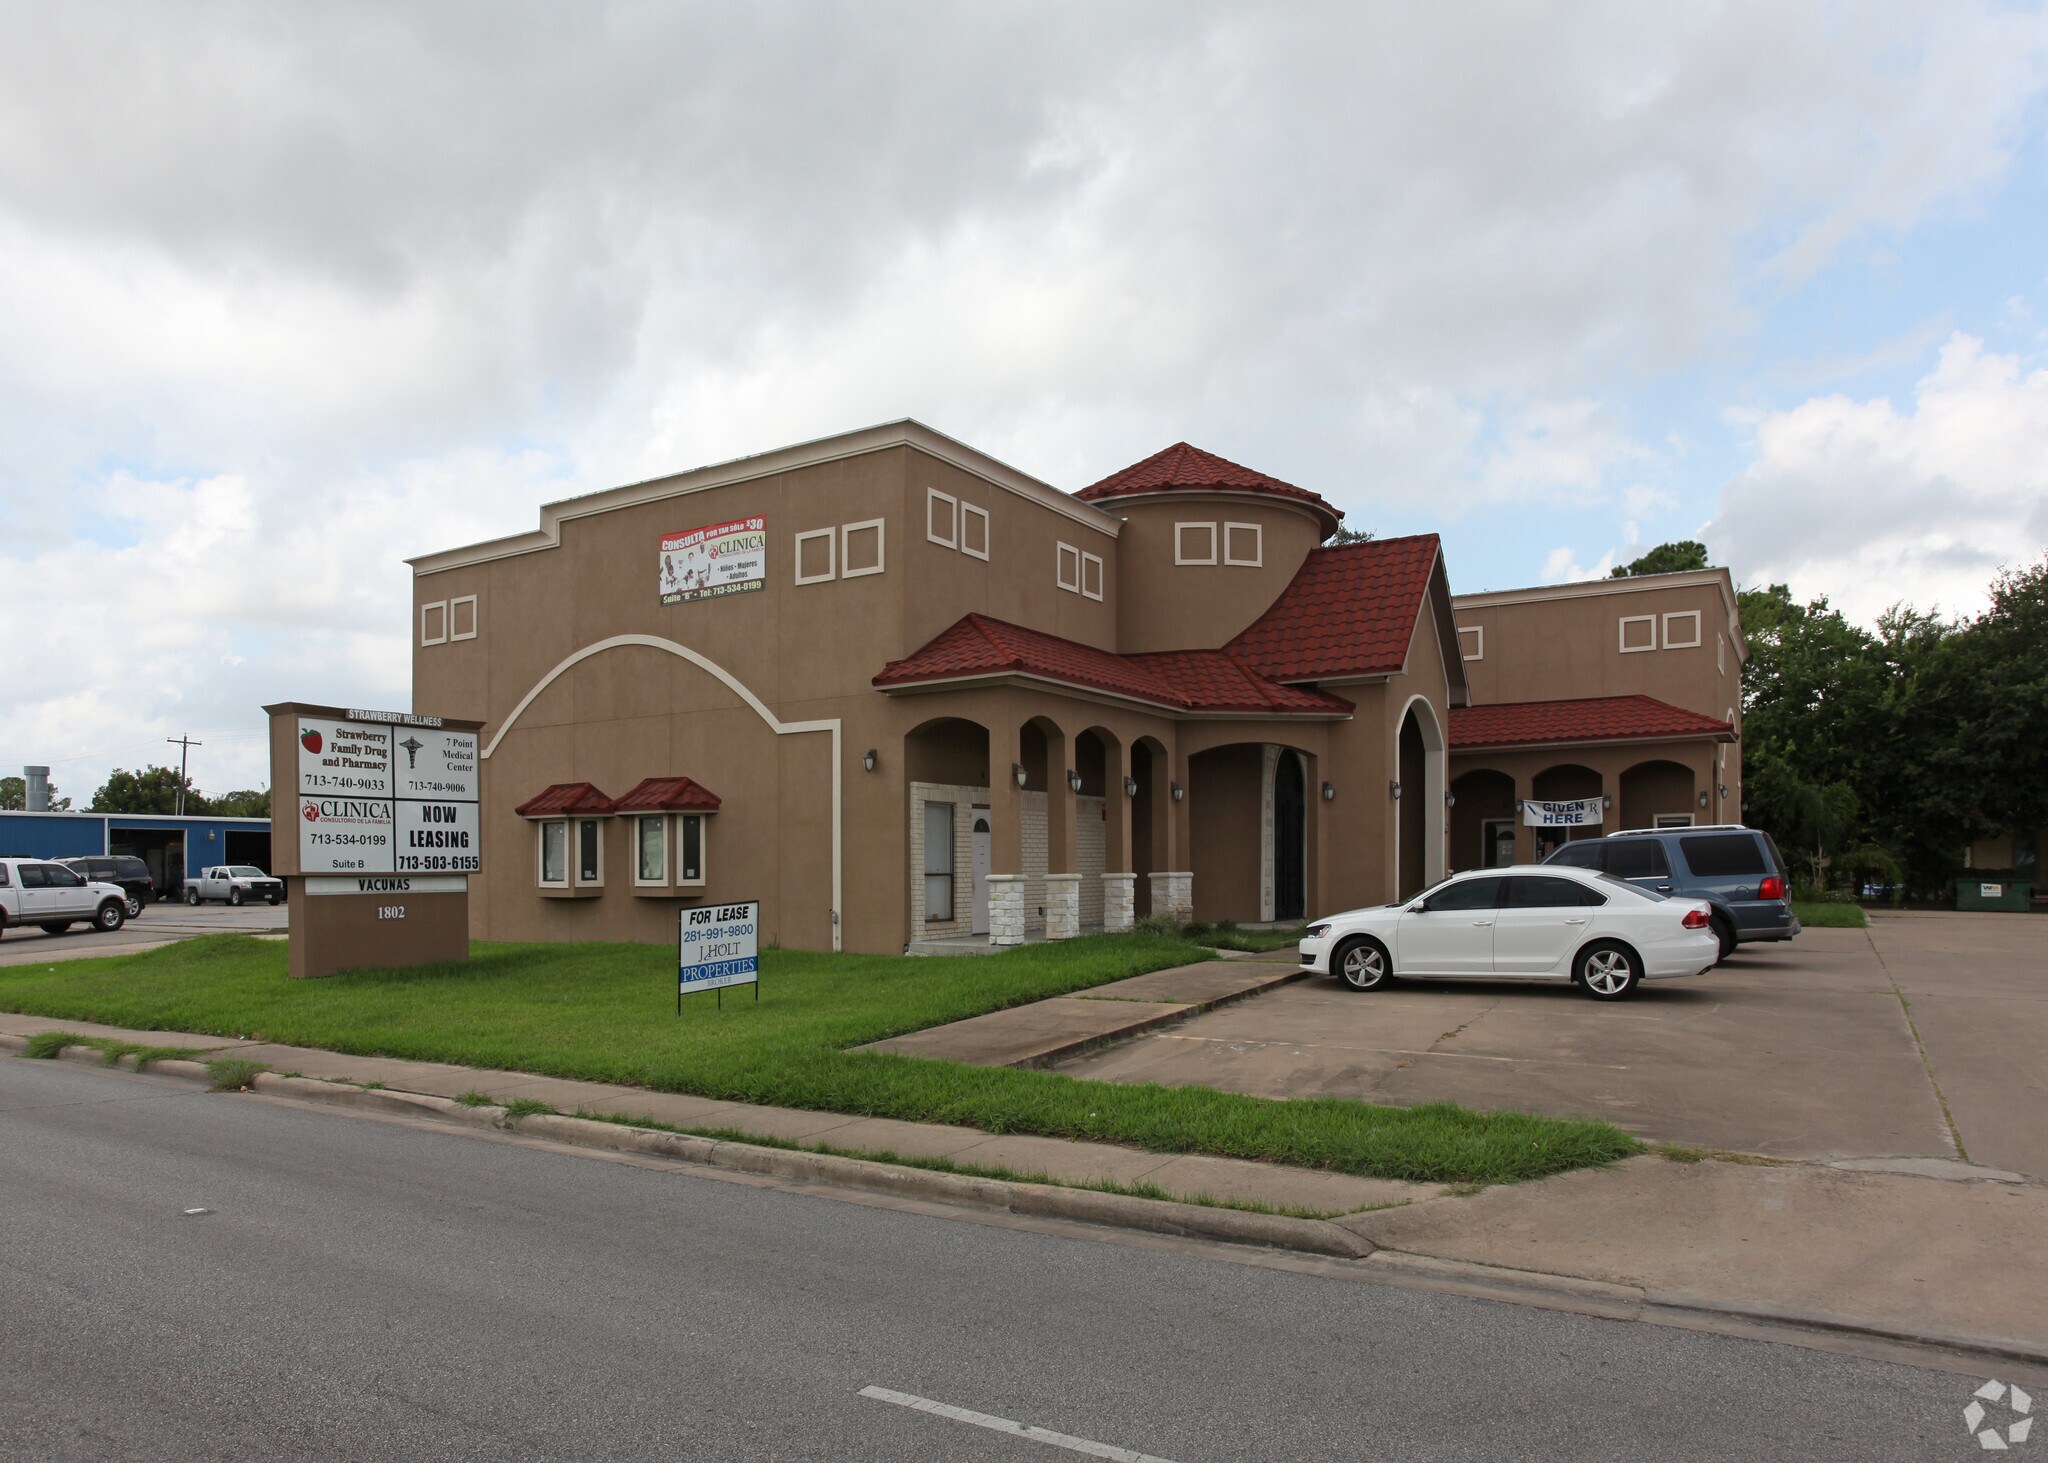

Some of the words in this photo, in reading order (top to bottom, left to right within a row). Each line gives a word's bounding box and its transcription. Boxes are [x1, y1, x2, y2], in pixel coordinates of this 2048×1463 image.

[662, 531, 705, 551] CONSULTA
[706, 530, 718, 539] POR
[718, 526, 729, 535] TAN
[746, 518, 763, 530] $30
[719, 535, 764, 554] CLINICA
[737, 560, 758, 570] Mujeres
[729, 571, 748, 580] Adultos
[663, 594, 681, 604] Suite
[713, 580, 761, 596] 713-534-0199
[348, 709, 401, 724] STRAWBERRY
[403, 714, 442, 727] WELLNESS
[335, 728, 387, 744] Strawberry
[446, 738, 451, 747] 7
[453, 738, 473, 748] Point
[330, 742, 362, 757] Family
[364, 745, 388, 759] Drug
[442, 750, 473, 760] Medical
[322, 757, 340, 767] and
[342, 757, 387, 772] Pharmacy
[447, 762, 473, 772] Center
[305, 774, 385, 791] 713-740-9033
[409, 780, 466, 793] 713-740-9006
[321, 800, 391, 819] CLINICA
[1543, 801, 1584, 812] GIVEN
[422, 805, 457, 823] NOW
[1543, 813, 1583, 824] HERE
[311, 833, 386, 845] 713-534-0199
[410, 830, 469, 848] LEASING
[332, 859, 356, 869] Suite
[358, 860, 364, 868] B
[399, 856, 479, 870] 713-503-6155
[358, 878, 410, 891] VACUNAS
[377, 906, 405, 918] 1802
[689, 910, 711, 925] FOR
[716, 906, 749, 922] LEASE
[684, 923, 753, 943] 281-991-9800
[683, 958, 755, 982] PROPERTIES
[707, 976, 732, 987] BROKER
